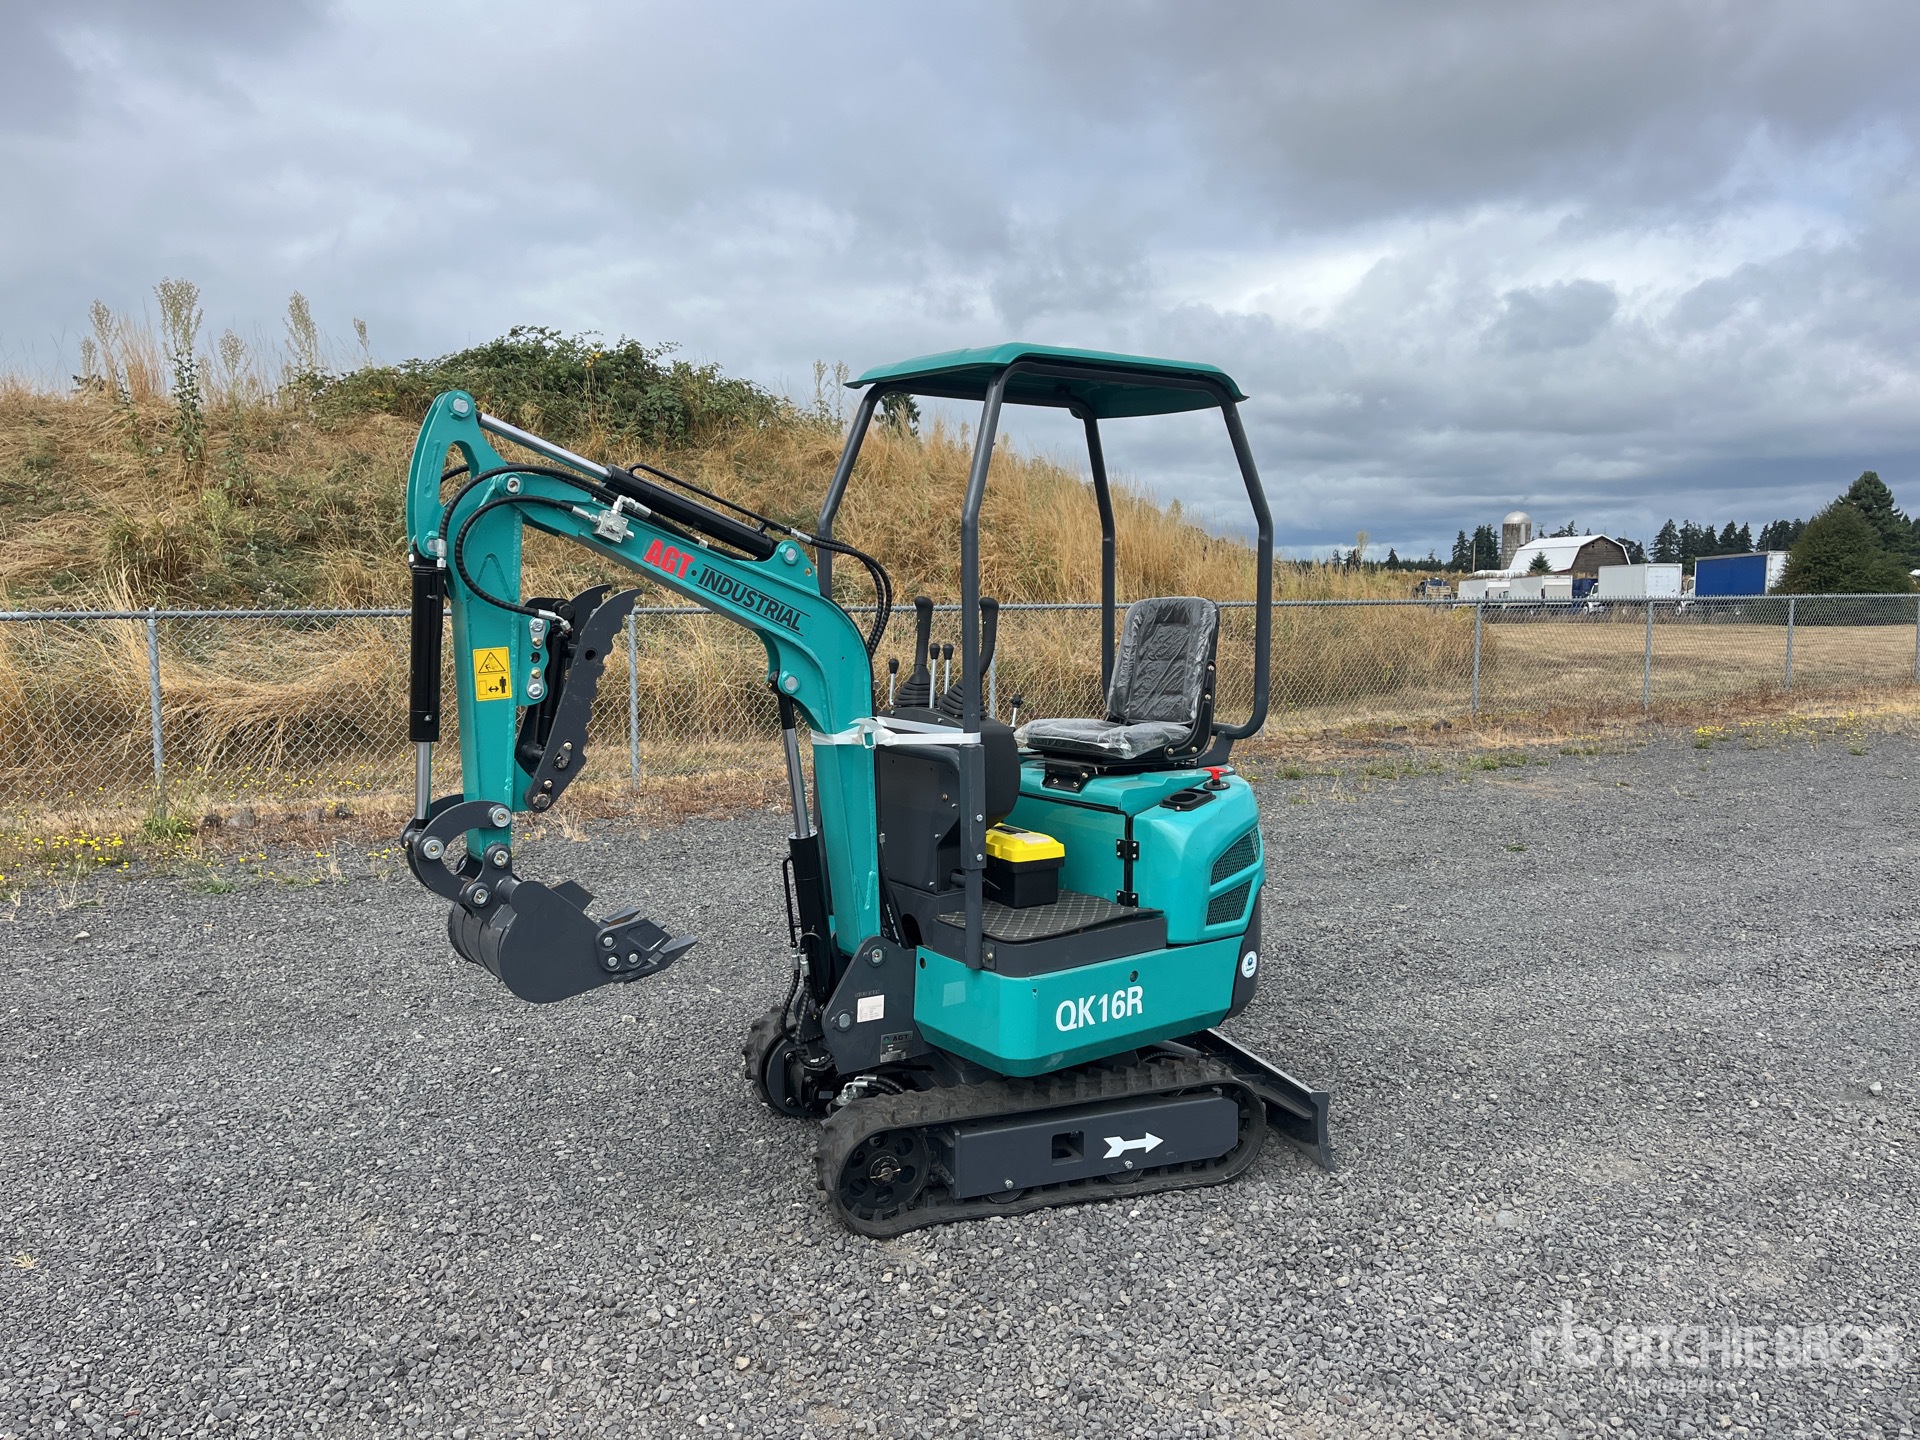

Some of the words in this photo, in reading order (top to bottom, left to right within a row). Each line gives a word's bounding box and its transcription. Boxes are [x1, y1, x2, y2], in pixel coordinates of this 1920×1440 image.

[643, 538, 695, 580] AGT
[697, 567, 801, 632] INDUSTRIAL
[1055, 985, 1144, 1032] QK16R
[892, 1034, 909, 1042] AGT
